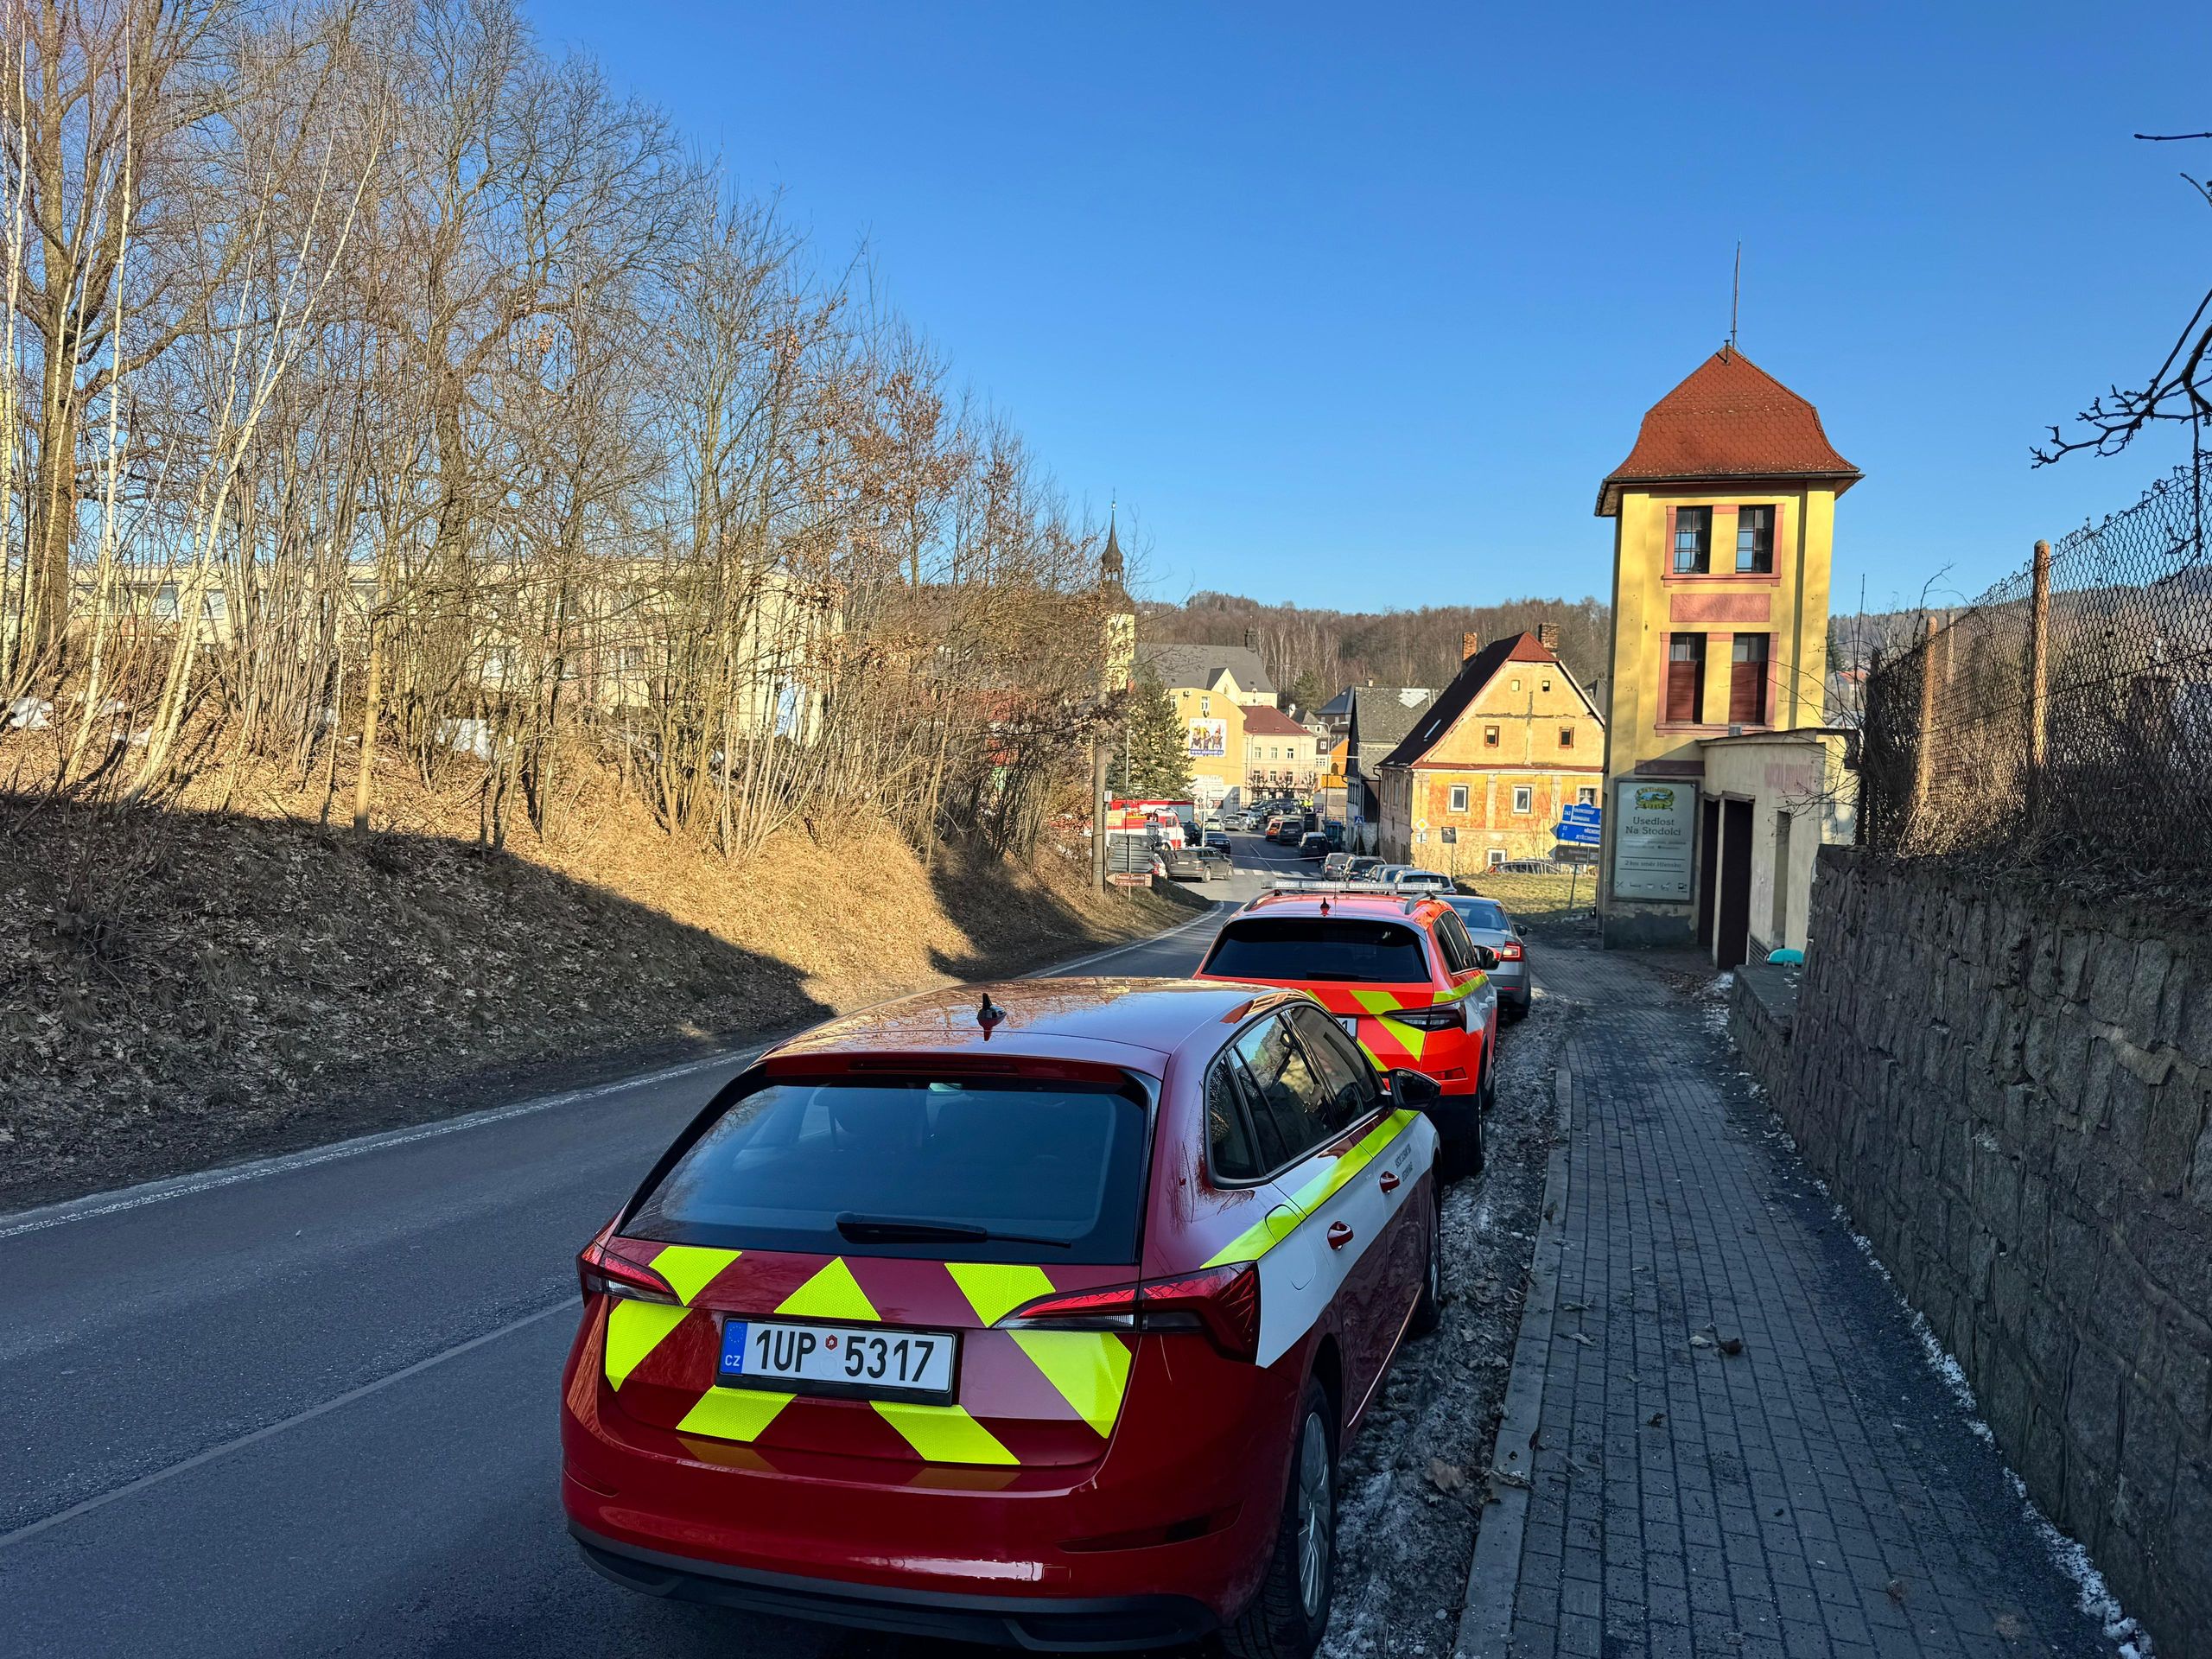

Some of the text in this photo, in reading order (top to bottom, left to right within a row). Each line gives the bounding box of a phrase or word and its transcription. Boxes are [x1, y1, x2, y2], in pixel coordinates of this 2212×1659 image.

[1632, 817, 1675, 826] Usedlost
[1625, 826, 1681, 836] Na Stodolci
[724, 1354, 741, 1367] CZ
[756, 1329, 935, 1382] 1UP 5317
